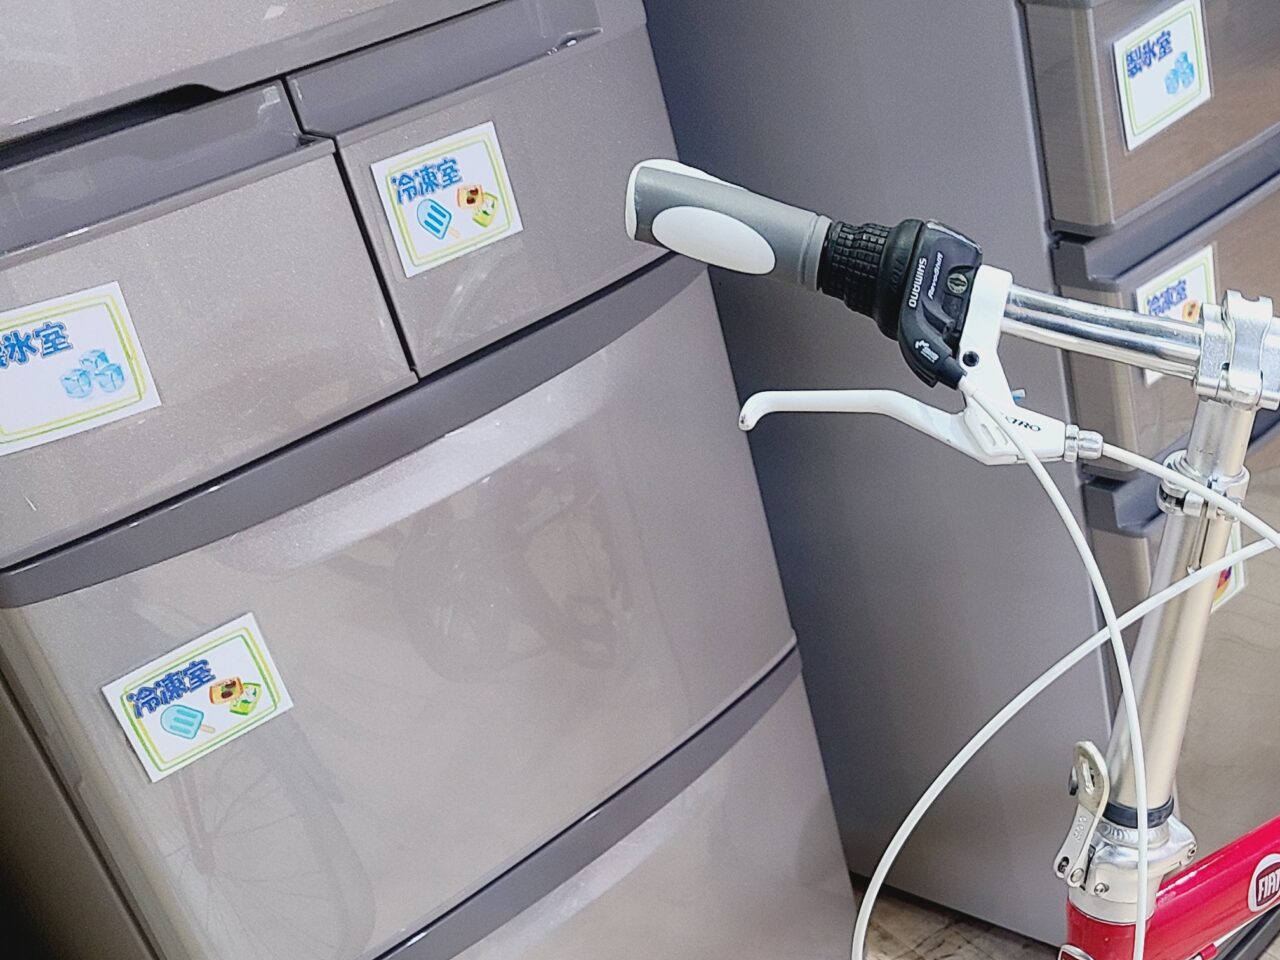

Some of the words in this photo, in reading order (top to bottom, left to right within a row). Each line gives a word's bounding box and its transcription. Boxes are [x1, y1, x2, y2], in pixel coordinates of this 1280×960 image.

[1126, 30, 1173, 78] 製氷室
[391, 158, 463, 205] 冷凍室
[909, 257, 927, 308] SHIMANO
[127, 659, 216, 719] 冷凍室
